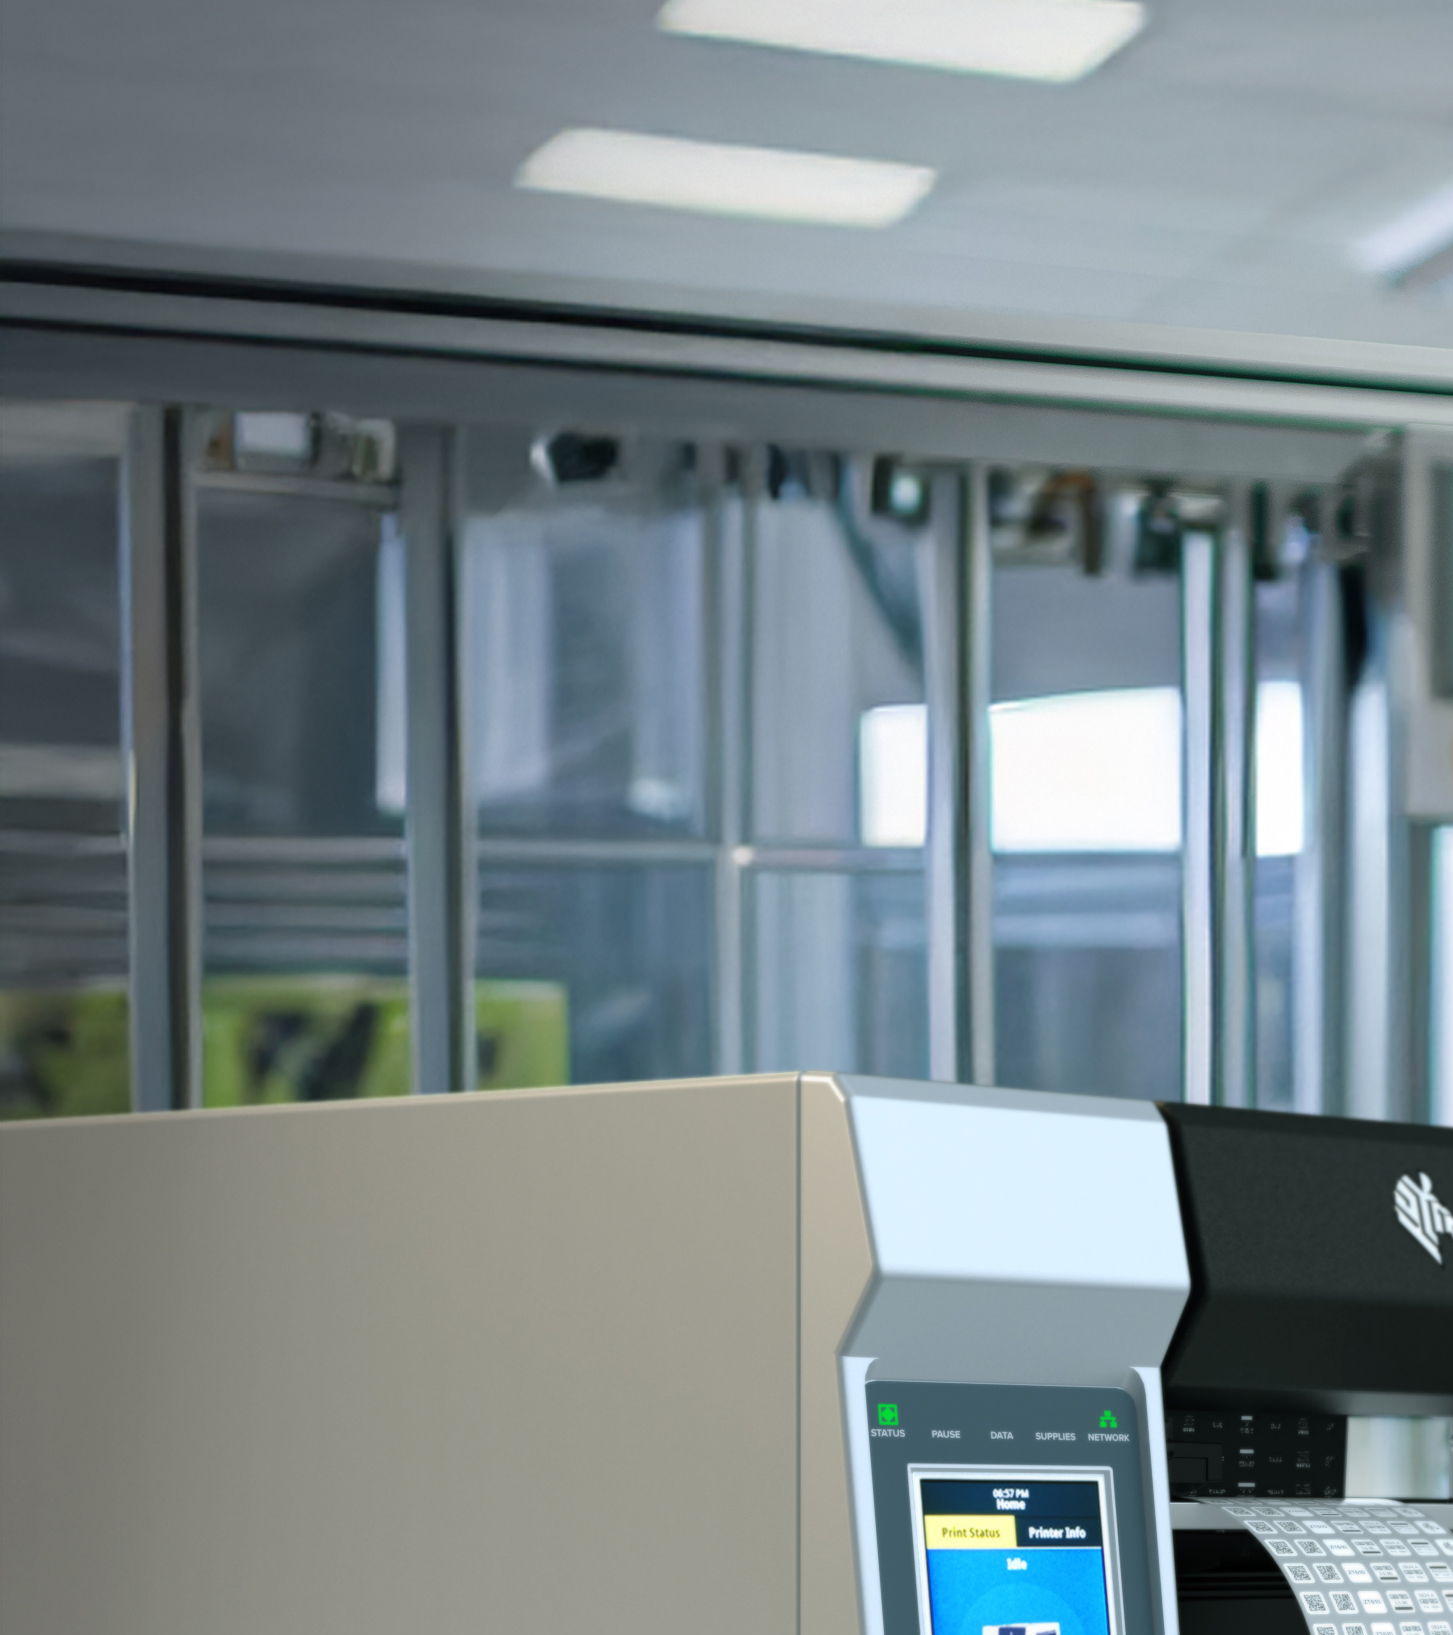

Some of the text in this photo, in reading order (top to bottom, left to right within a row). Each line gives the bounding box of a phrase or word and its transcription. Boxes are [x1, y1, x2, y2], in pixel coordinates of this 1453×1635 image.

[871, 1428, 1129, 1442] STATUS PAUSE DATA SUPPLIES NETWORK
[993, 1488, 1029, 1499] 06:57 PM
[996, 1499, 1025, 1511] Home
[942, 1526, 1000, 1539] Print Status
[1028, 1527, 1086, 1539] Printer Info
[1006, 1558, 1027, 1571] Idle
